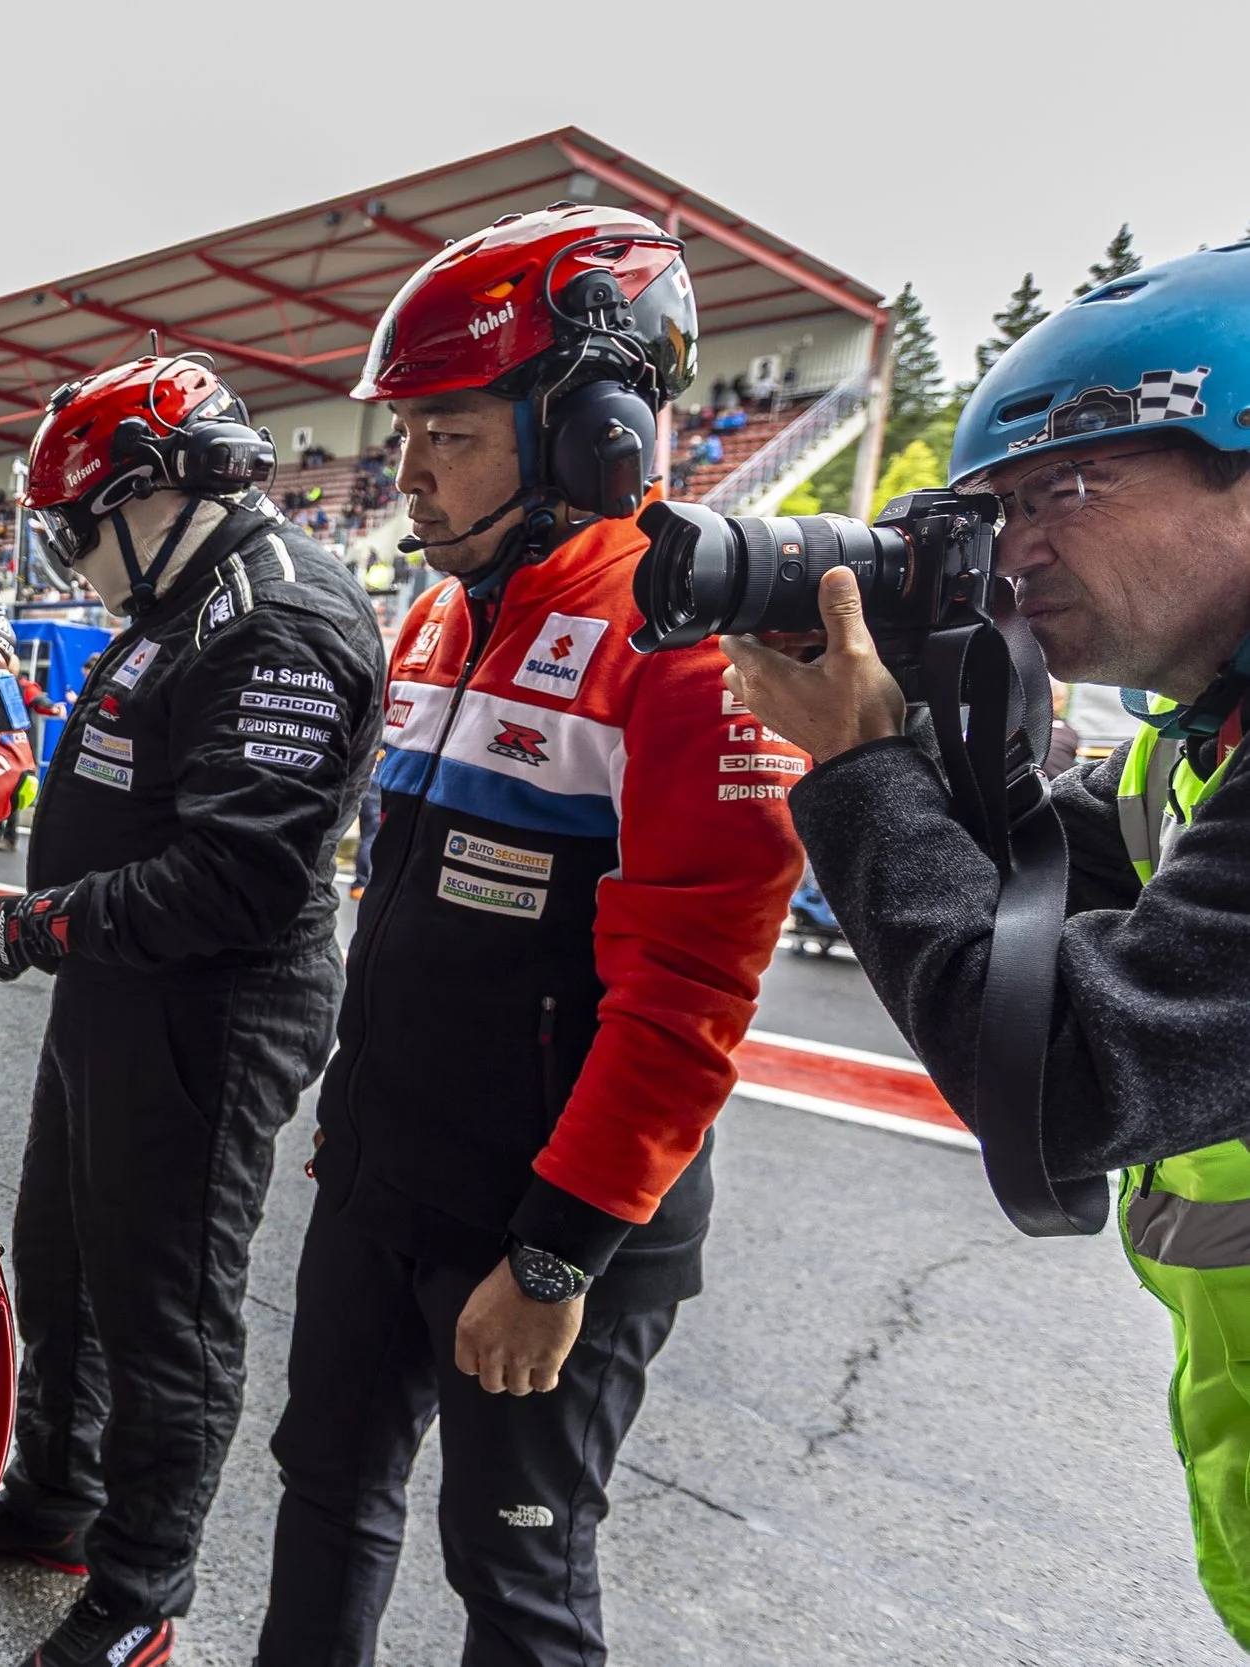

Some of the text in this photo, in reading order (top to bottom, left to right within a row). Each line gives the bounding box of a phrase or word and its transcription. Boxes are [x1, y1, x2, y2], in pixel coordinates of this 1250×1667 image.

[468, 301, 514, 340] Yohei
[66, 458, 101, 487] Tetsuro
[214, 595, 232, 624] OMP
[252, 665, 334, 692] La Sarthe
[526, 659, 578, 682] SUZUKI
[268, 697, 332, 717] FACOM
[255, 720, 299, 737] DISTRI
[302, 726, 332, 744] BIKE
[729, 724, 756, 742] La
[487, 743, 543, 766] GSX
[754, 757, 804, 772] FACOM
[739, 784, 784, 800] DISTRI
[446, 876, 514, 901] SECURITEST
[498, 1509, 536, 1520] NORTH
[515, 1504, 537, 1513] THE
[508, 1518, 534, 1527] FACE
